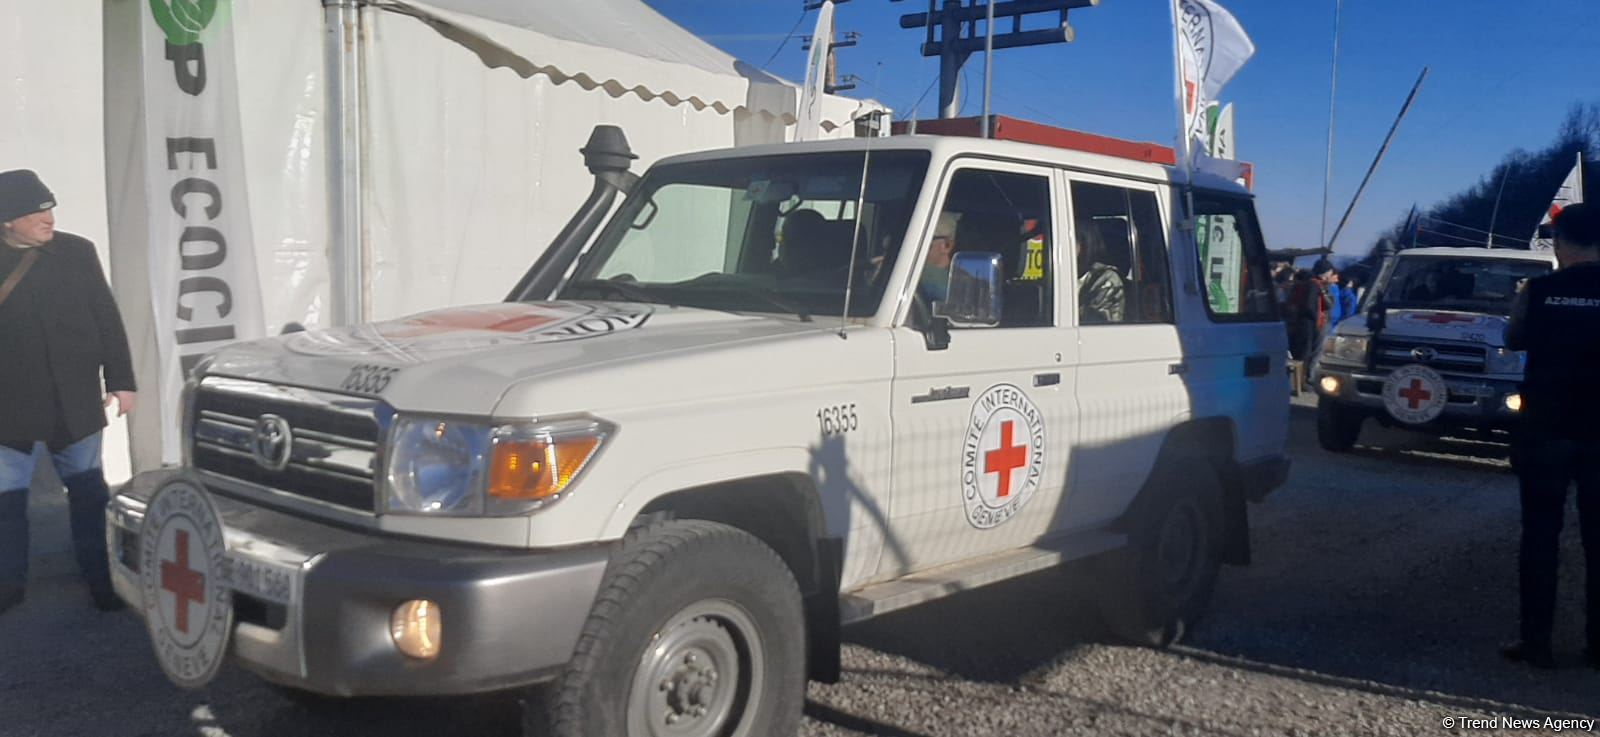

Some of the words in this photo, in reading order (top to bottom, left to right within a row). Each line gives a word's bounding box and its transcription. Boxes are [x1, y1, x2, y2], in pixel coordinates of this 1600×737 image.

[816, 403, 858, 435] 16355
[964, 416, 984, 500] COMITE
[980, 388, 1043, 489] INTERNATIONAL
[971, 498, 1021, 526] GENEVE
